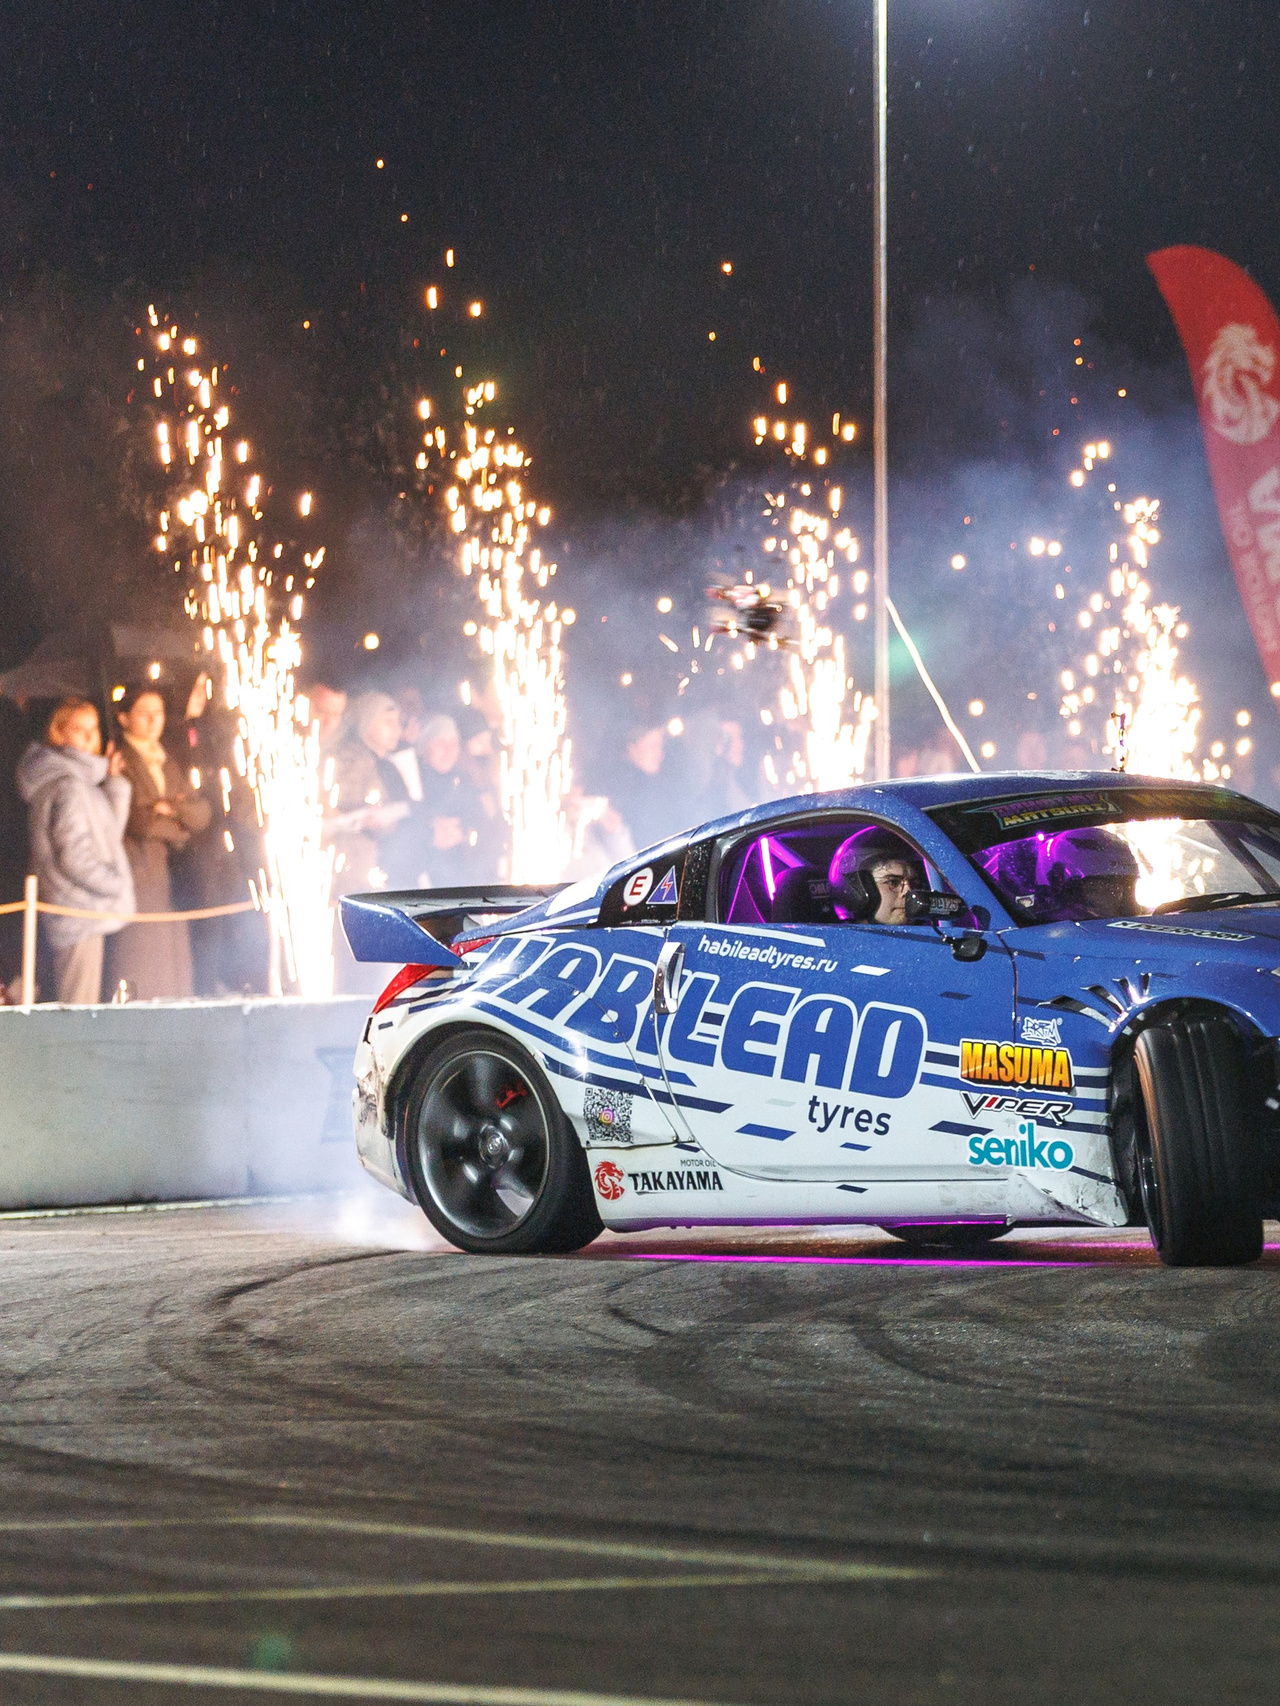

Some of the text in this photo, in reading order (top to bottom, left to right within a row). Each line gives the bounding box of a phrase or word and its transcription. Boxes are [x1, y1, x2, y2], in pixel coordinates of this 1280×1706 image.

[629, 876, 647, 896] E
[697, 934, 838, 973] habileadtyres.ru
[961, 1041, 1073, 1092] MASUMA
[808, 1095, 892, 1136] tyres
[961, 1092, 1071, 1125] VIPER
[680, 1159, 717, 1168] MOTOR OIL
[969, 1122, 1074, 1170] seniko
[628, 1171, 724, 1194] TAKAYAMA
